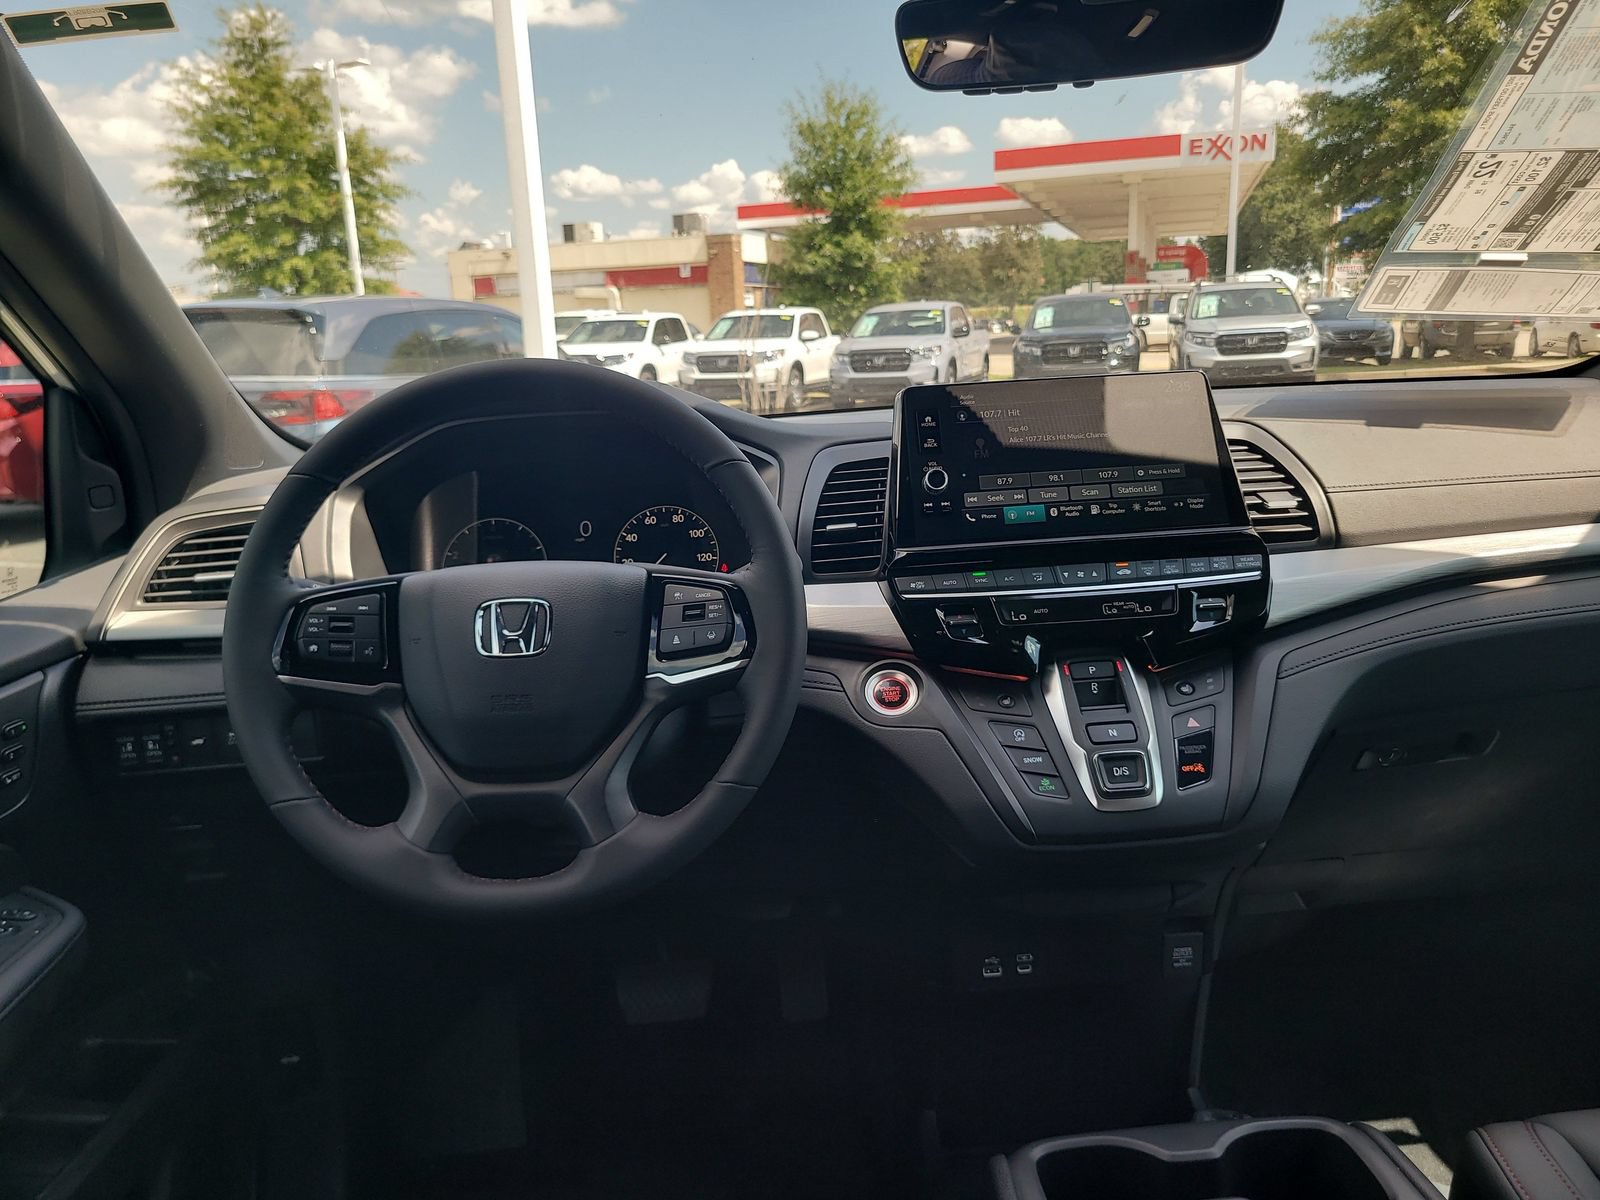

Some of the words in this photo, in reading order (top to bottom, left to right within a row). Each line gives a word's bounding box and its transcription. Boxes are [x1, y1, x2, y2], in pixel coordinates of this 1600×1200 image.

[1189, 134, 1266, 160] EXXON
[979, 409, 1002, 418] 107.7
[1007, 409, 1020, 417] Hit
[1007, 426, 1019, 434] Top
[1048, 474, 1064, 482] 98.1
[1098, 470, 1119, 479] 107.9
[997, 477, 1013, 485] 87.9
[1081, 488, 1099, 496] Scan
[1118, 485, 1143, 494] Station
[1144, 484, 1157, 492] List
[987, 494, 1005, 502] Seek
[644, 516, 657, 525] 60
[672, 514, 684, 523] 80
[579, 520, 592, 537] 0
[625, 533, 638, 542] 40
[689, 529, 705, 538] 100
[696, 553, 712, 561] 120
[1088, 666, 1096, 675] P
[1091, 683, 1098, 691] R
[1108, 729, 1117, 737] N
[1023, 756, 1042, 764] SNOW
[1113, 766, 1129, 777] D/S
